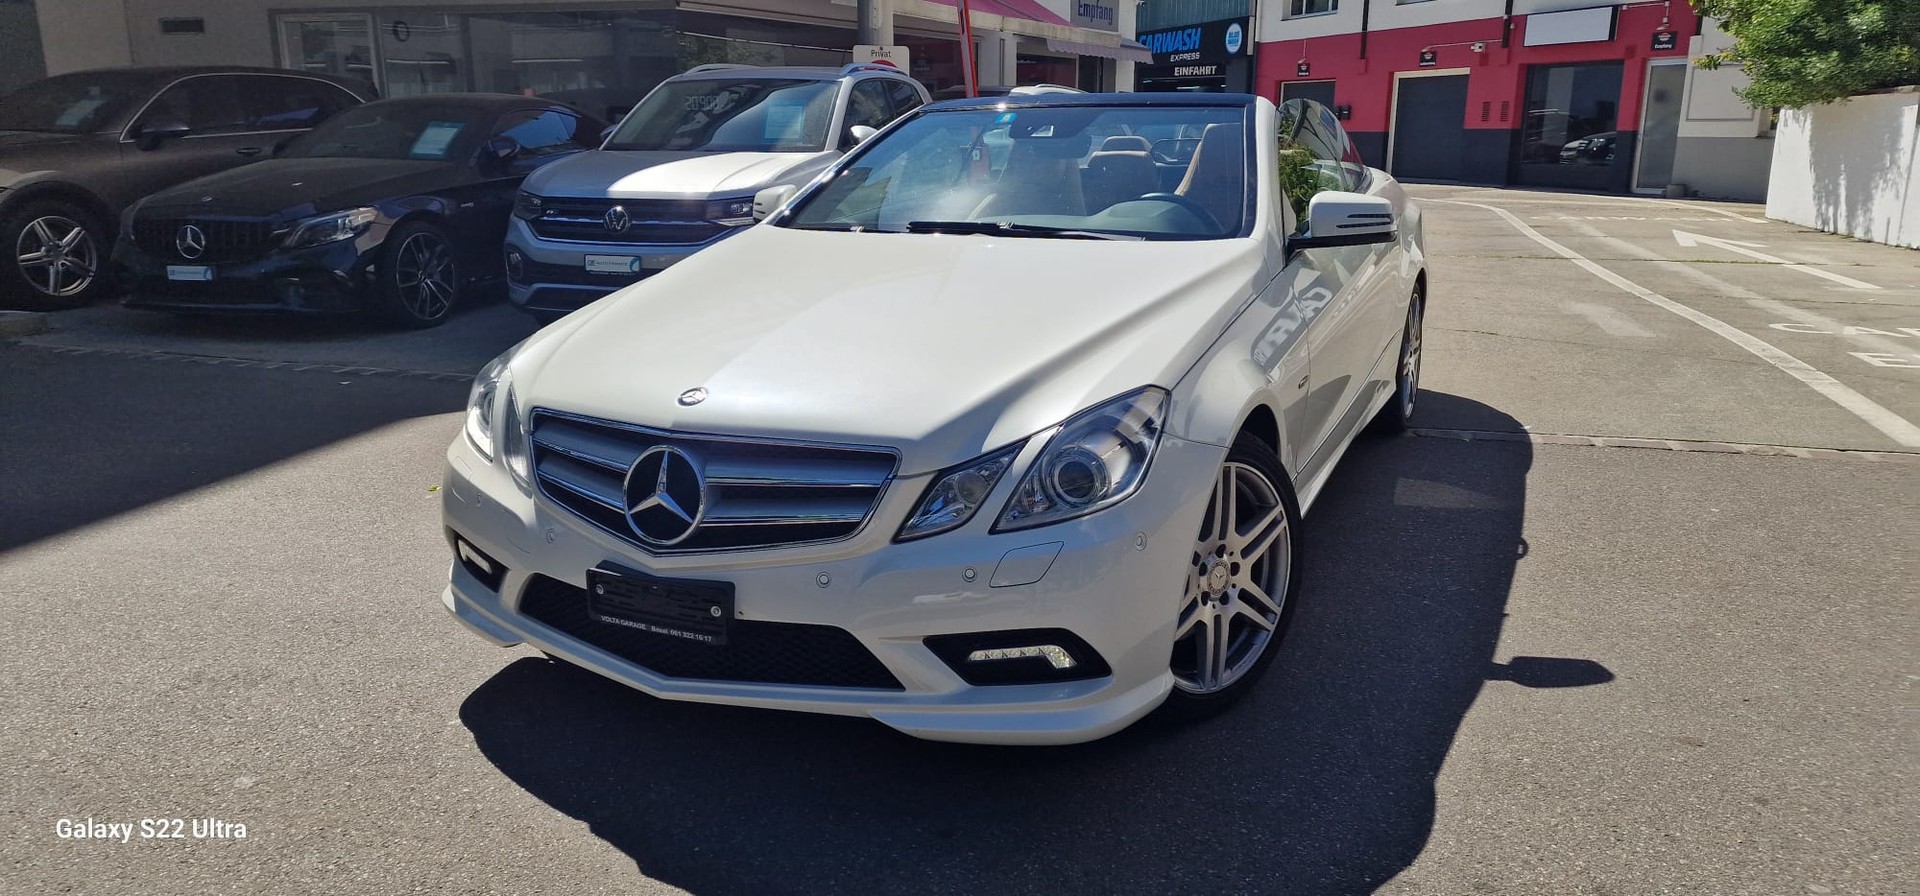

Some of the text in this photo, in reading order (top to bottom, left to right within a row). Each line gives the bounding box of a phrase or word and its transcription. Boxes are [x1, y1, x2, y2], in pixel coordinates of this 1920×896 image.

[1078, 0, 1113, 25] Empfang
[1170, 52, 1200, 62] EXPRESS
[1174, 66, 1217, 76] EINFAHRT
[620, 620, 646, 630] GARAGE
